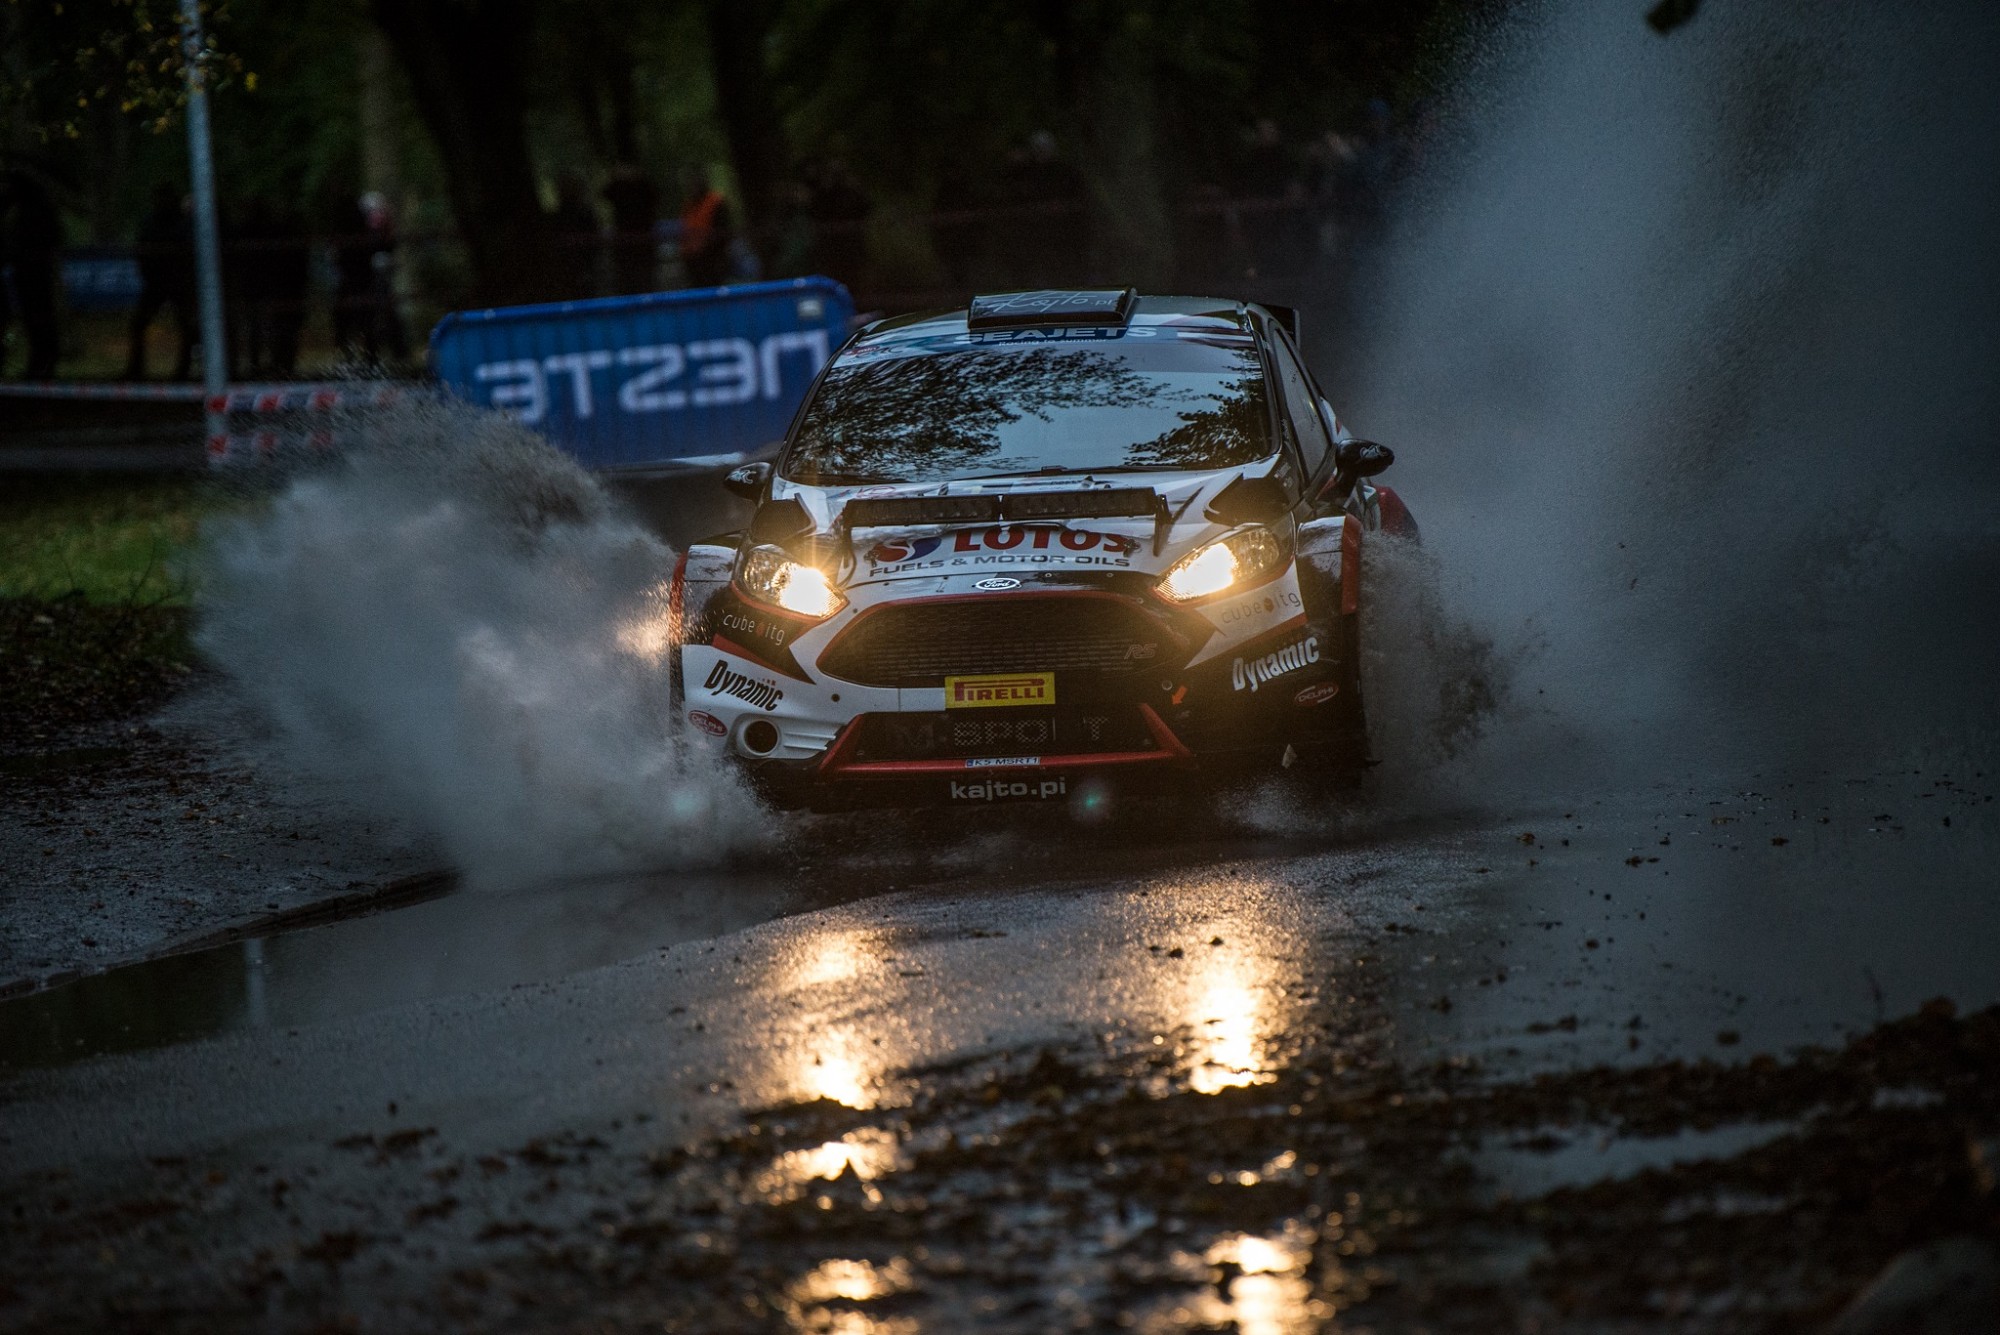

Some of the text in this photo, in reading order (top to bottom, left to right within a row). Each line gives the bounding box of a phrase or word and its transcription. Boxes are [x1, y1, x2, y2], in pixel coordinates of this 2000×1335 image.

[955, 327, 1158, 345] SEAJETS
[953, 525, 1133, 552] LOTOS
[869, 555, 1131, 577] FUELS & MOTOR OILS
[722, 613, 756, 633] cube
[1222, 600, 1263, 624] cube
[1232, 636, 1320, 693] Dynamic
[704, 659, 784, 712] Dynamic
[954, 678, 1045, 702] PIRELLI
